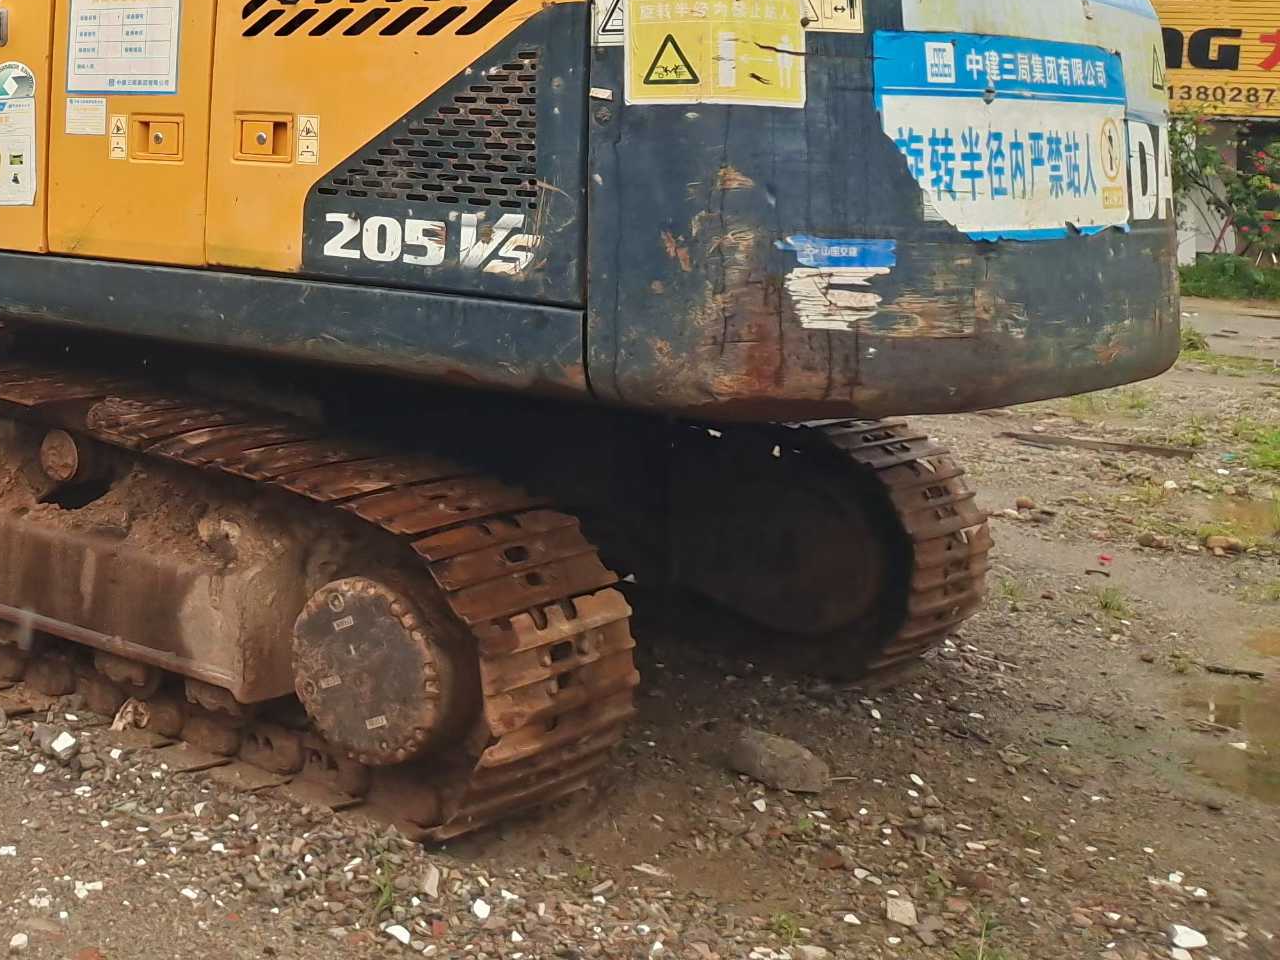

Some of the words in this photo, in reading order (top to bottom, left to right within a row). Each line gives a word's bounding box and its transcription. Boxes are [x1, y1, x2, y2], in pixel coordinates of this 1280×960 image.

[965, 48, 1108, 88] 中建三局集团有限公司
[323, 212, 447, 267] 205
